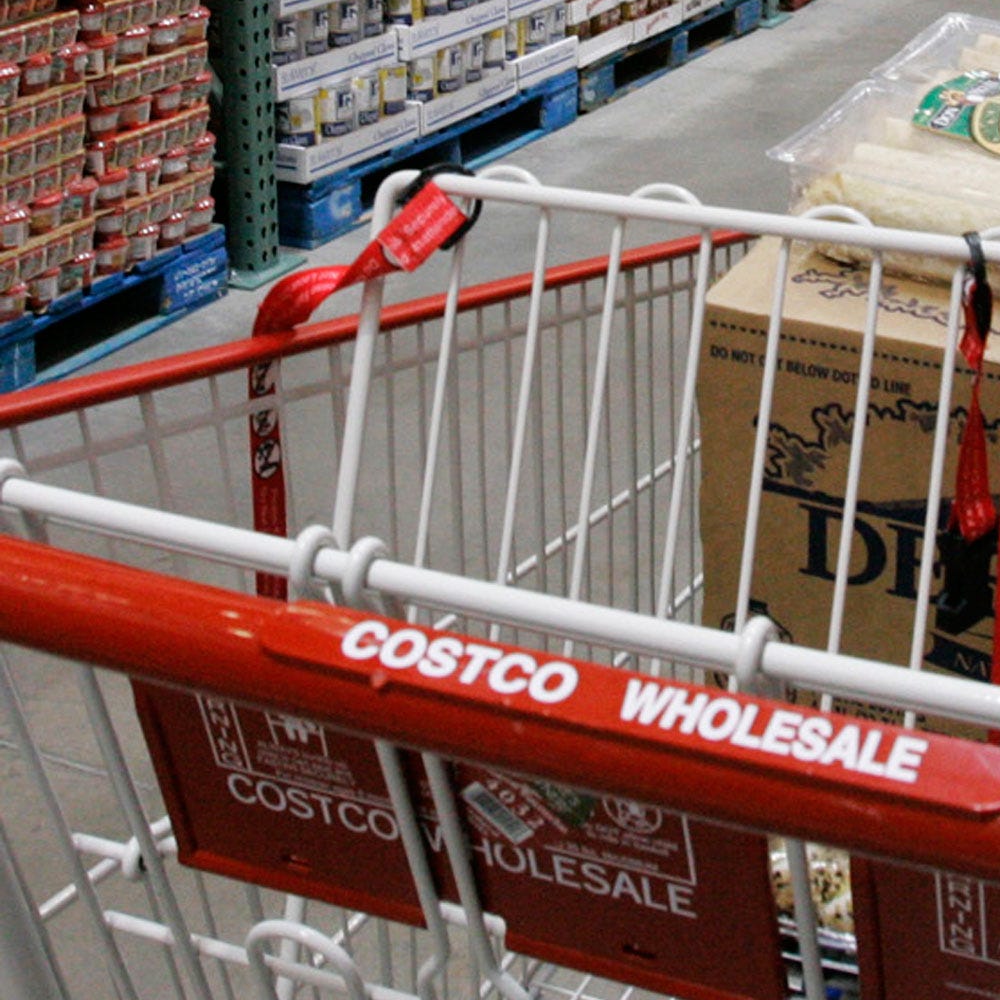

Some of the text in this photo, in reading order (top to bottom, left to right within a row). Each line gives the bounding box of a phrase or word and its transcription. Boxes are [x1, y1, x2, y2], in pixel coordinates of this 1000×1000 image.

[710, 344, 912, 395] DO NOT CT BELOW DOTD LINE
[340, 620, 579, 704] COSTCO
[619, 678, 930, 784] WHOLESALE
[227, 773, 400, 841] COSTCO
